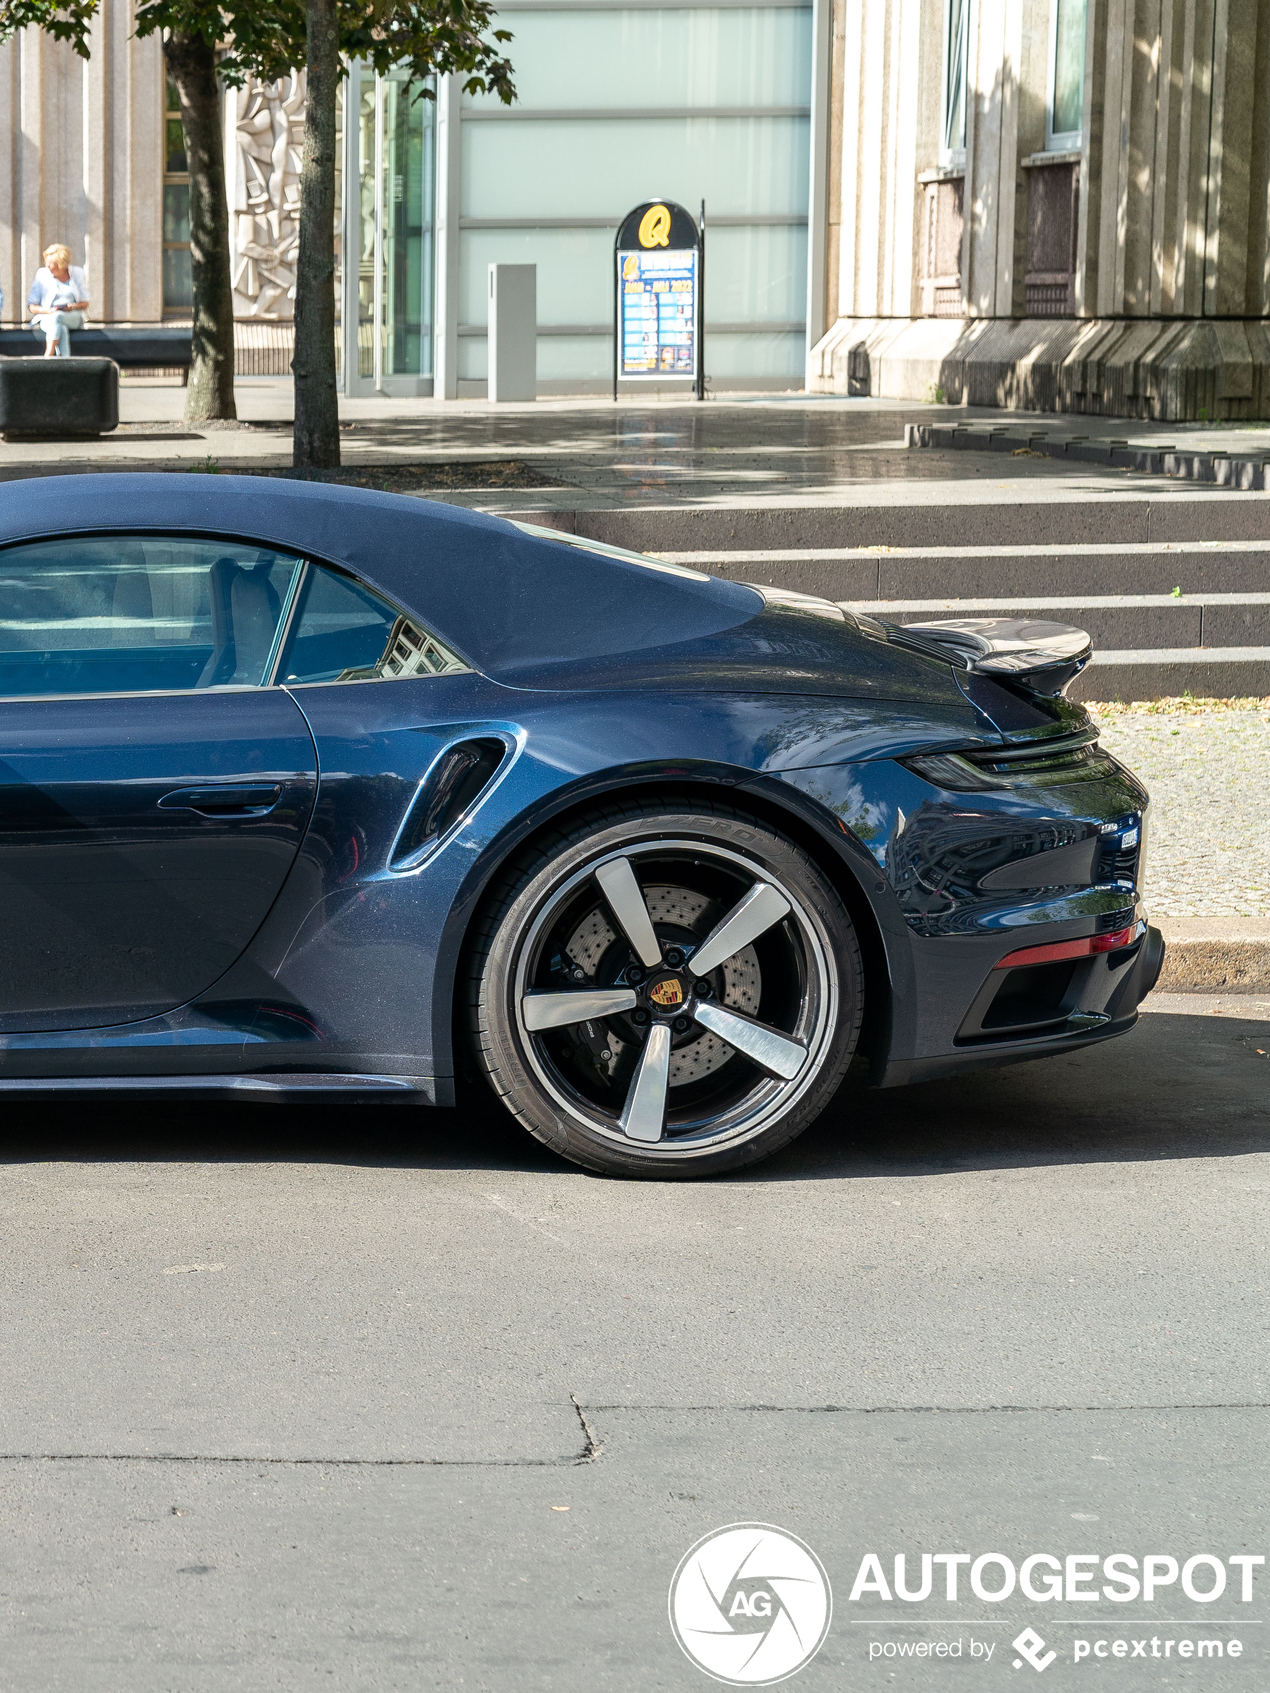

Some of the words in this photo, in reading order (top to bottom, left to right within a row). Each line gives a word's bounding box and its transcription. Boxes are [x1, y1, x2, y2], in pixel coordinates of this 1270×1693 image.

[639, 205, 671, 248] Q
[671, 279, 693, 292] 2022
[639, 817, 659, 829] P
[666, 815, 757, 843] ZERO
